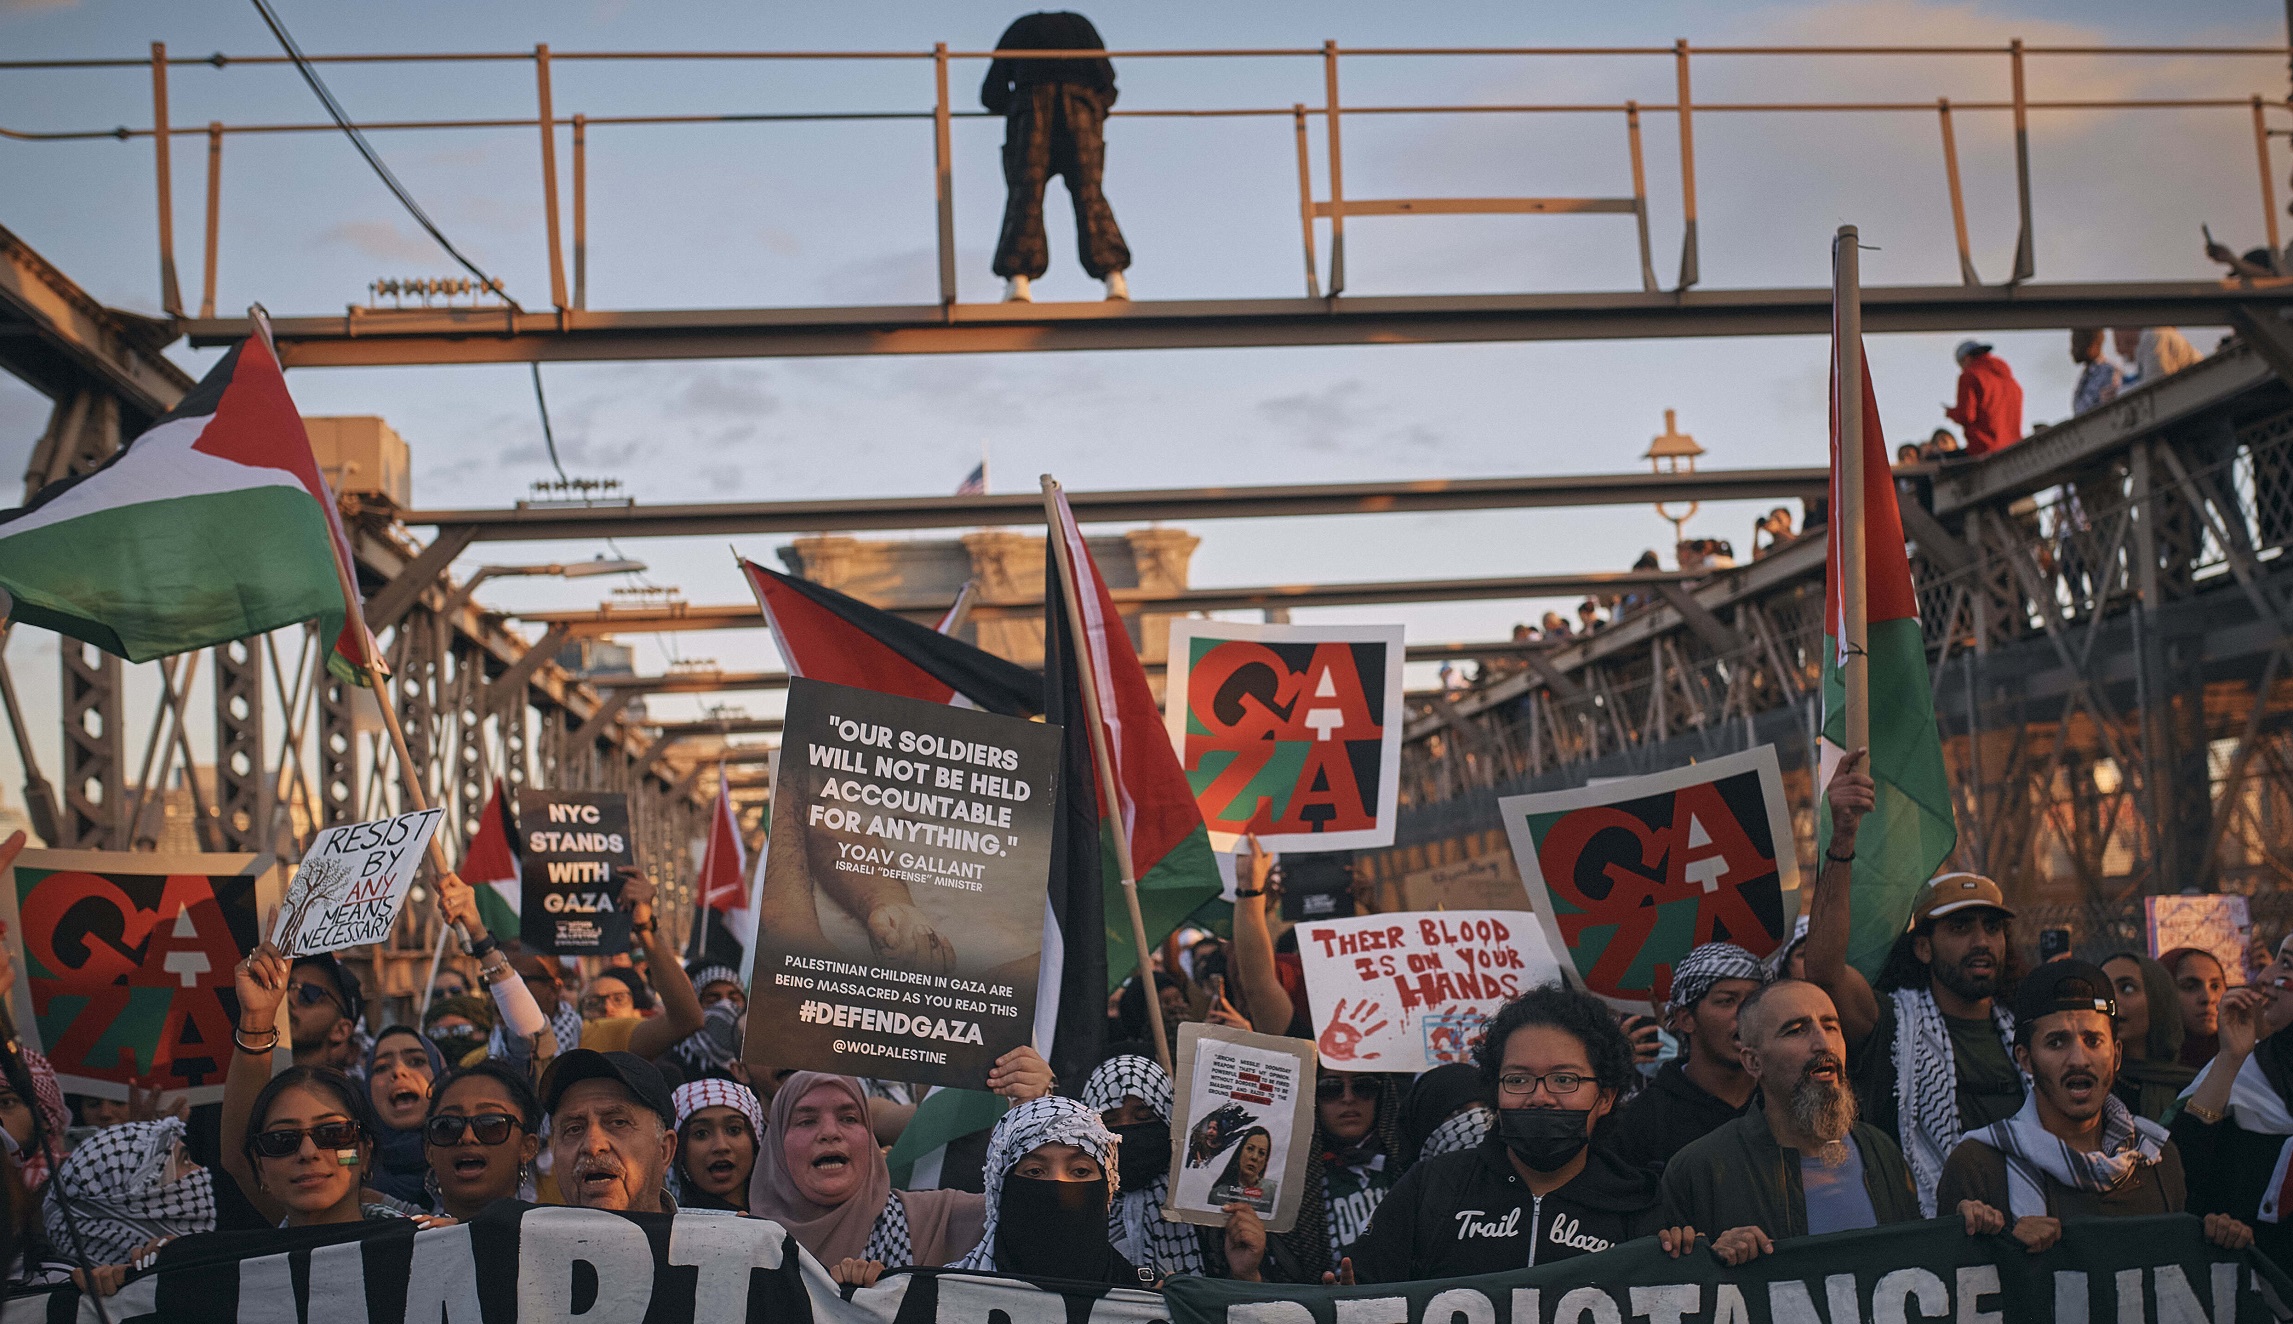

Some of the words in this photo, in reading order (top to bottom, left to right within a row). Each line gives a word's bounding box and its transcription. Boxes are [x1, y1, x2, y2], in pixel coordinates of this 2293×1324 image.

[830, 715, 893, 749] "OUR
[899, 730, 1019, 771] SOLDIERS
[808, 743, 868, 774] WILL
[875, 756, 930, 784] NOT
[935, 766, 964, 791] BE
[970, 773, 1031, 801] HELD
[548, 803, 600, 825] NYC
[820, 777, 1011, 828] ACCOUNTABLE
[323, 810, 441, 855] RESIST
[530, 831, 624, 853] STANDS
[809, 805, 861, 833] FOR
[866, 816, 1018, 857] ANYTHING."
[360, 847, 405, 878] BY
[548, 862, 610, 883] WITH
[836, 860, 874, 875] ISRAELI
[934, 877, 983, 892] MINISTER
[838, 842, 894, 865] YOAV
[899, 853, 985, 880] GALLANT
[345, 872, 397, 902] ANY
[544, 893, 614, 913] GAZA
[319, 895, 394, 927] MEANS
[297, 915, 395, 951] NECESSARY
[1312, 926, 1405, 958] THEIR
[1419, 918, 1510, 947] BLOOD
[785, 955, 867, 977] PALESTINIAN
[870, 968, 931, 986] CHILDREN
[934, 977, 947, 988] IN
[950, 979, 986, 994] GAZA
[989, 984, 1013, 997] ARE
[1355, 955, 1396, 981] IS
[1407, 952, 1443, 974] ON
[1457, 946, 1525, 974] YOUR
[775, 974, 814, 989] BEING
[817, 980, 899, 1000] MASSACRED
[902, 992, 921, 1004] AS
[925, 995, 951, 1008] YOU
[955, 999, 986, 1013] READ
[990, 1003, 1018, 1017] THIS
[1394, 972, 1519, 1007] HANDS
[799, 1000, 984, 1045] #DEFENDGAZA
[833, 1039, 947, 1064] @WOLPALESTINE
[1212, 1068, 1237, 1077] POWERFUL
[1455, 1207, 1521, 1240] Trail
[1550, 1212, 1615, 1253] blaze
